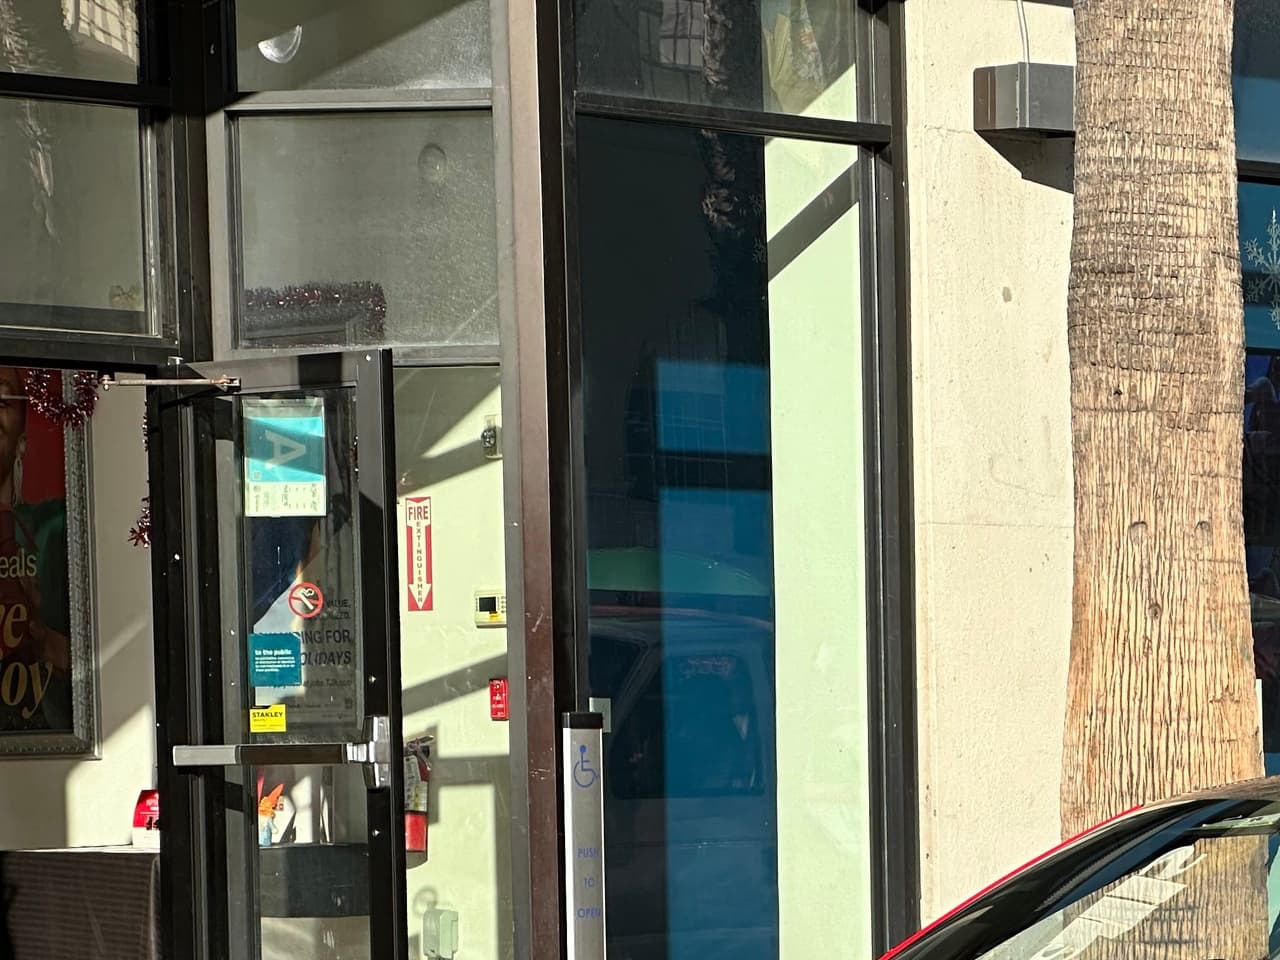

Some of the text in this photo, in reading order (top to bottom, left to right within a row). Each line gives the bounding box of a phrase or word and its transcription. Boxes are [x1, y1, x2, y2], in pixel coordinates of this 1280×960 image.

[408, 506, 429, 521] FIRE
[416, 521, 424, 603] EXTINGUISHER
[0, 603, 27, 648] e
[325, 630, 352, 643] FOR
[301, 651, 352, 665] OLIDAYS
[0, 655, 53, 719] oy
[578, 847, 600, 857] PUSH
[583, 878, 595, 887] TO
[578, 908, 601, 919] OPEN
